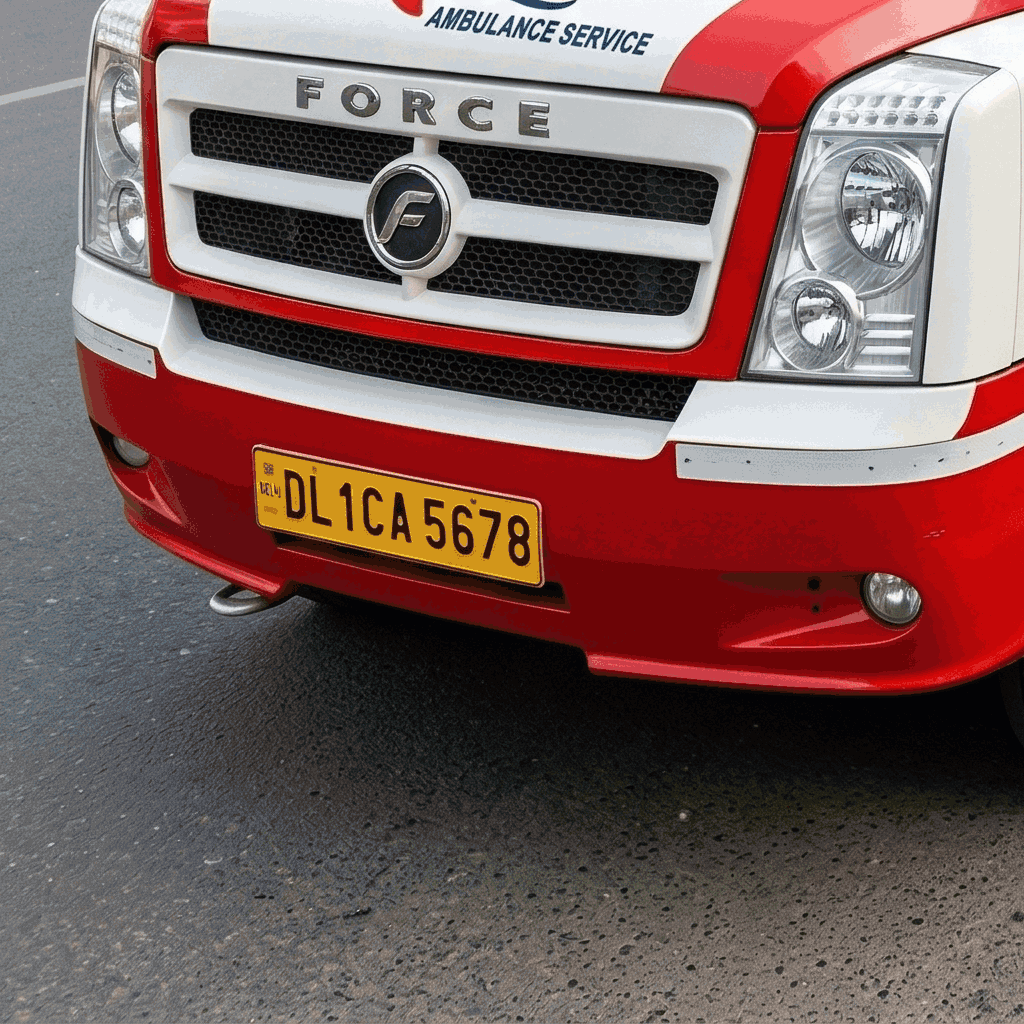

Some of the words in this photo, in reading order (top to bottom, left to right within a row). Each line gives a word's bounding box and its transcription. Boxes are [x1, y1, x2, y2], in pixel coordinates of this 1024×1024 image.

[424, 5, 560, 44] AMBULANCE
[558, 22, 655, 56] SERVICE
[296, 74, 551, 139] FORCE
[422, 496, 532, 568] 5678
